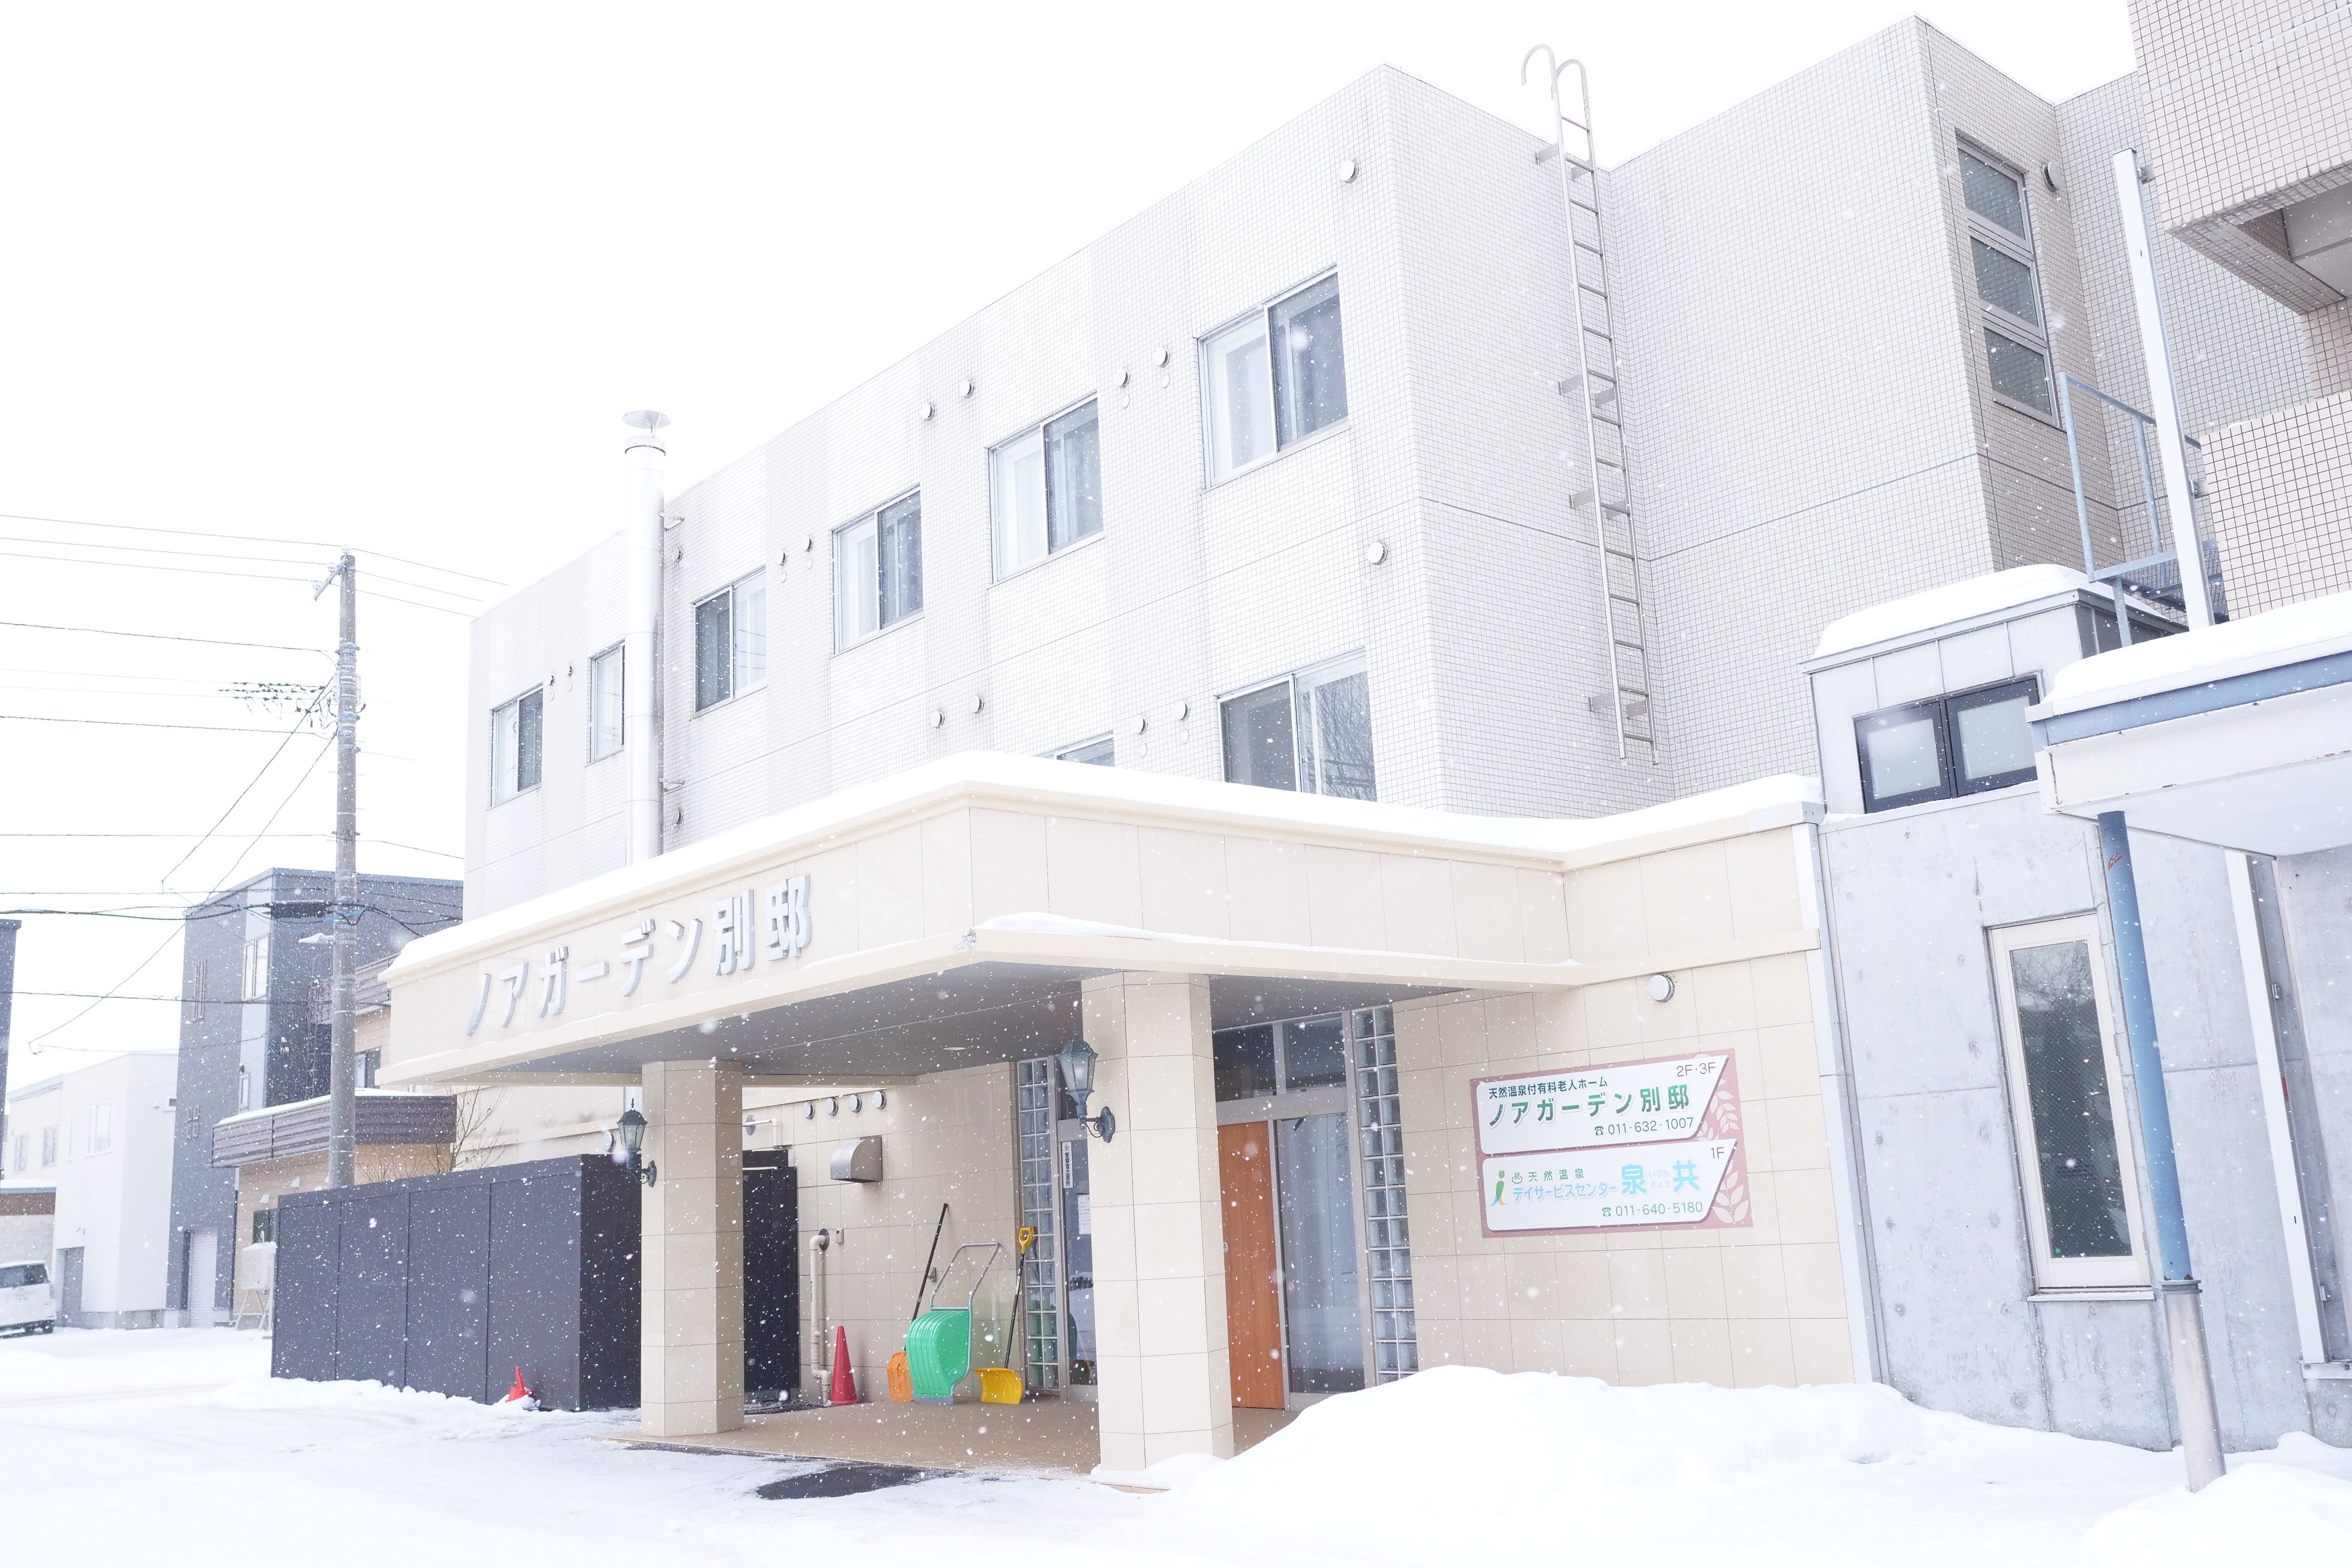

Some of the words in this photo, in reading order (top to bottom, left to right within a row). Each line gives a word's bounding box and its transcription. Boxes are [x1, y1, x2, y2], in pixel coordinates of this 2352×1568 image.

[465, 874, 812, 1036] ノアガーデン別邸
[1489, 1077, 1608, 1099] 天然温泉付有料老人ホーム
[1490, 1084, 1689, 1126] ノアガーデン別邸
[1608, 1117, 1694, 1135] 011-632-1007
[1710, 1147, 1725, 1159] 1F
[1528, 1168, 1584, 1182] 天然温泉
[1649, 1170, 1670, 1178] いずみ
[1513, 1181, 1617, 1201] デイサービスセンター
[1650, 1180, 1671, 1189] きょう
[1616, 1201, 1703, 1216] 011-640-5180
